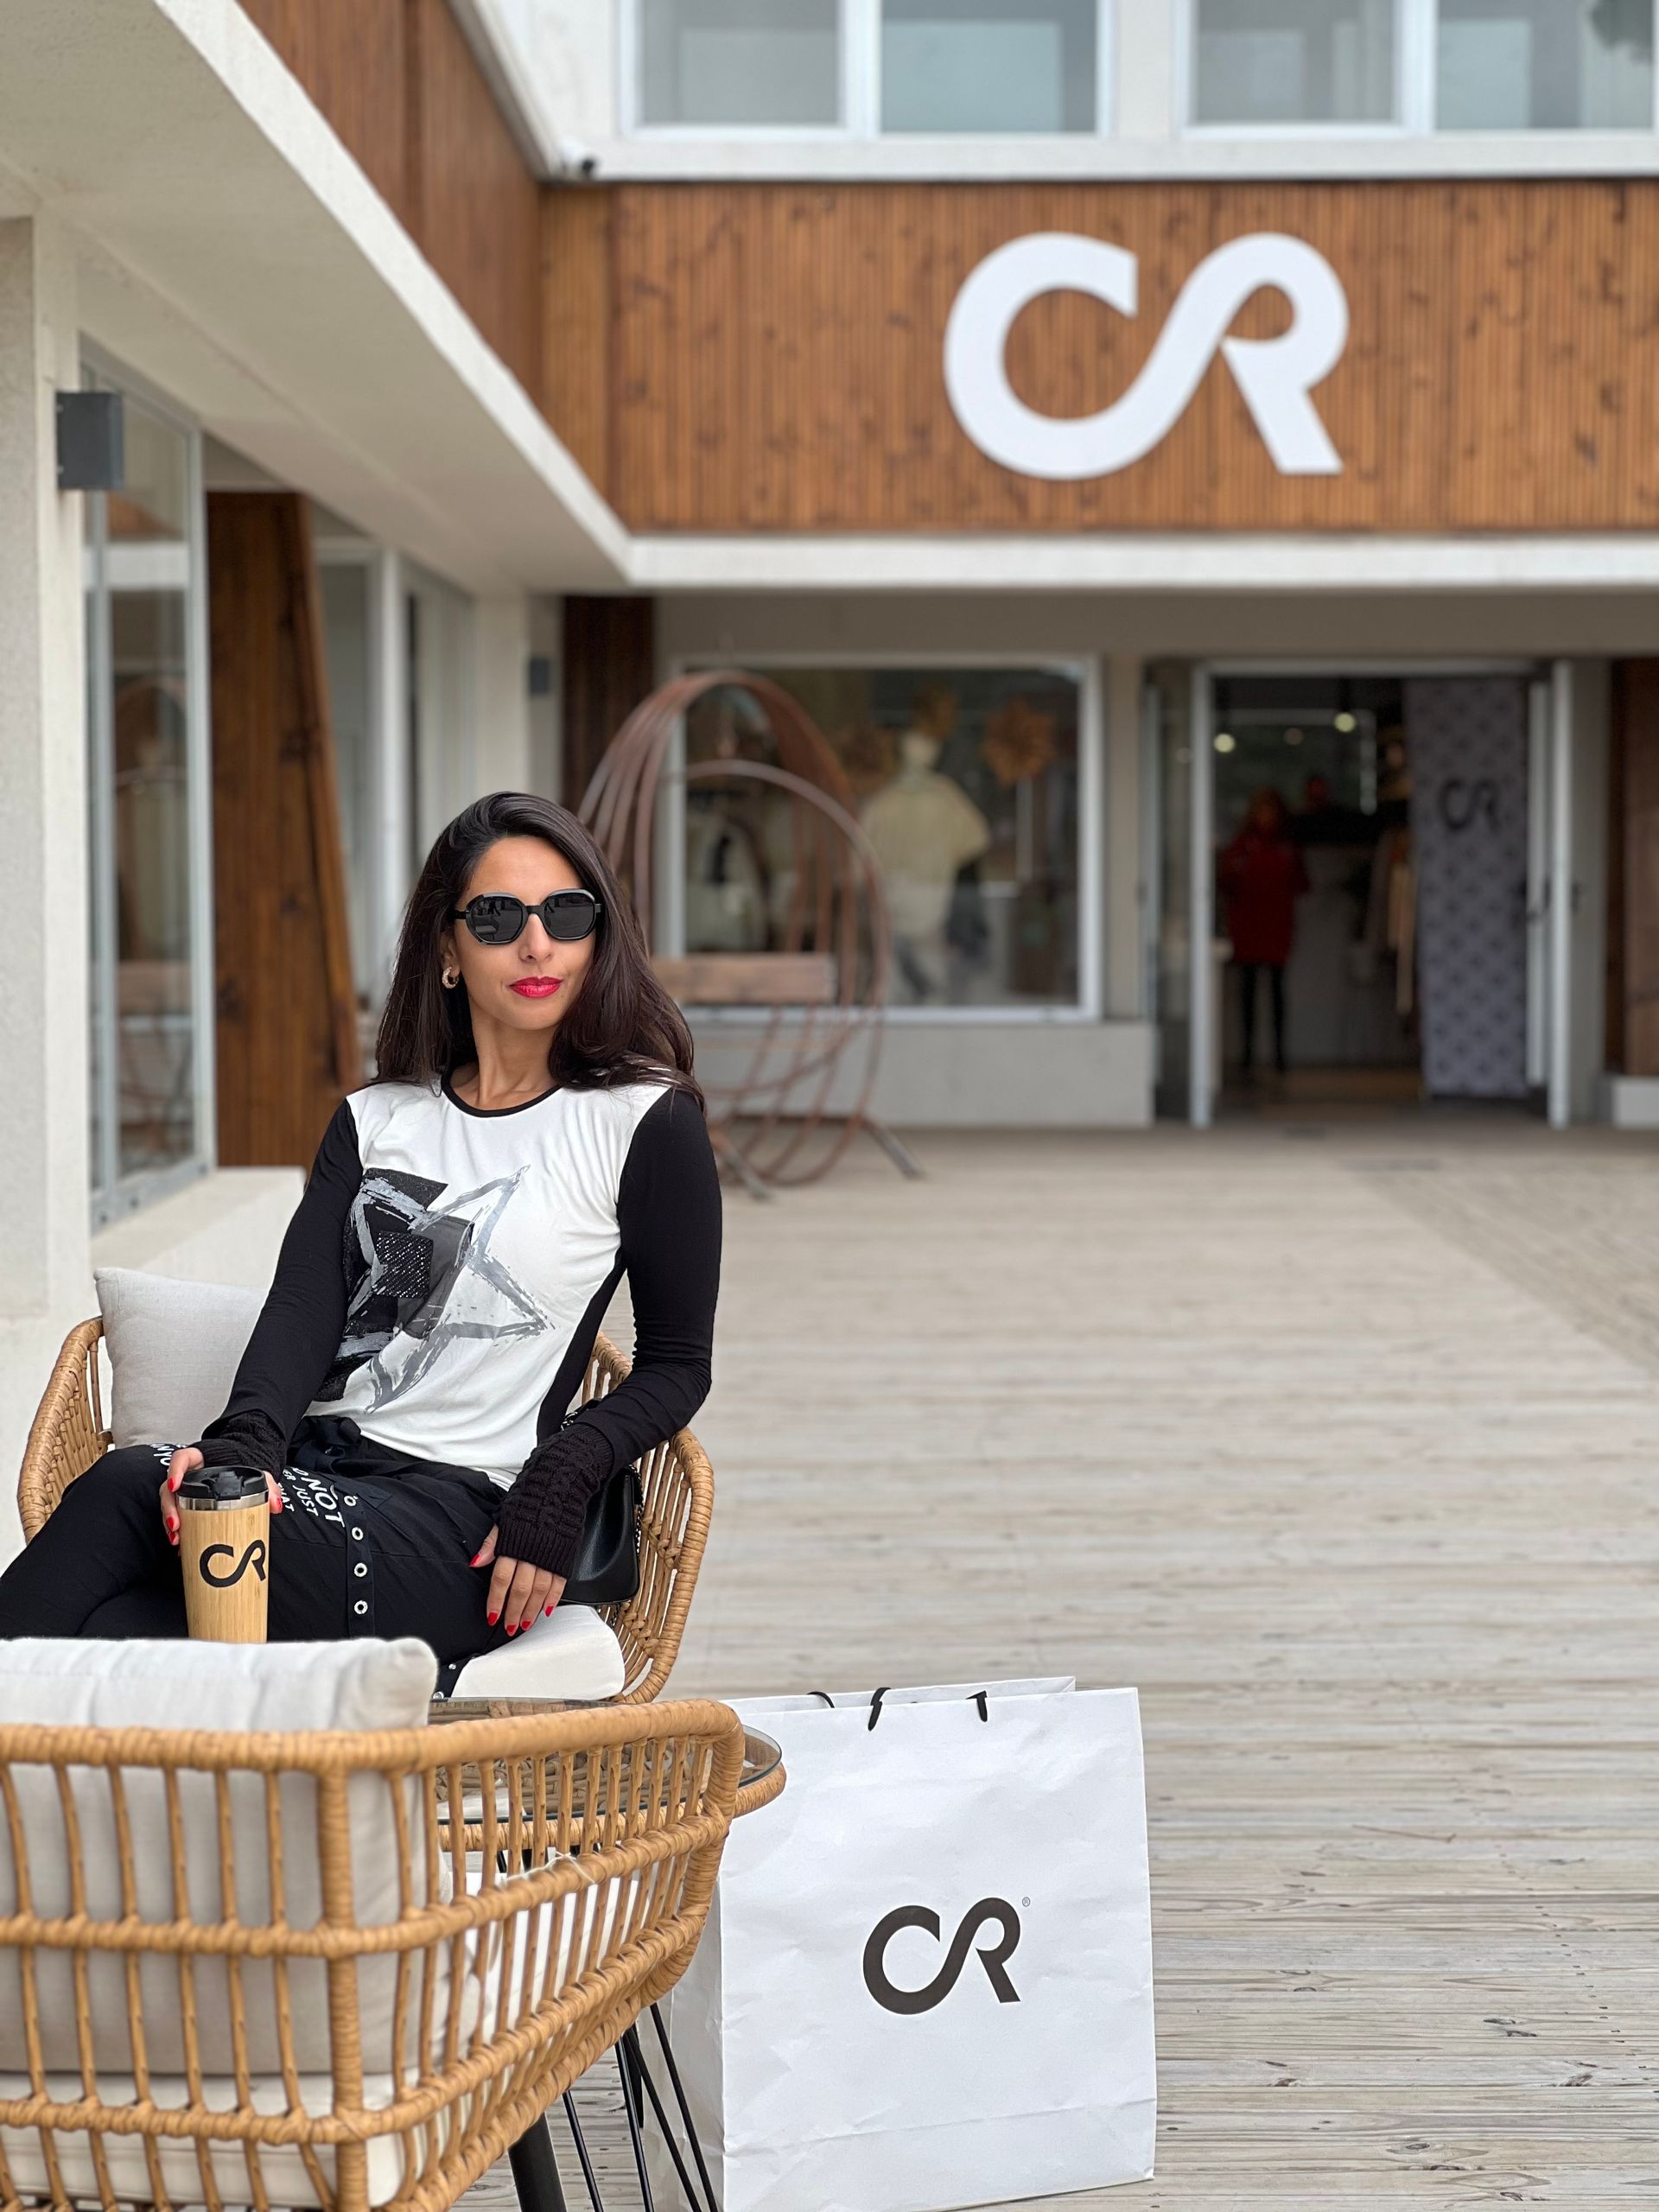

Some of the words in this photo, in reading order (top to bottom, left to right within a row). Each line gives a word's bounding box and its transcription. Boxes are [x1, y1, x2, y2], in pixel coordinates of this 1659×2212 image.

[944, 232, 1349, 480] CR
[292, 1484, 319, 1516] JUST
[300, 1477, 346, 1528] NOT
[199, 1539, 267, 1588] CR
[862, 1897, 1021, 2016] CR
